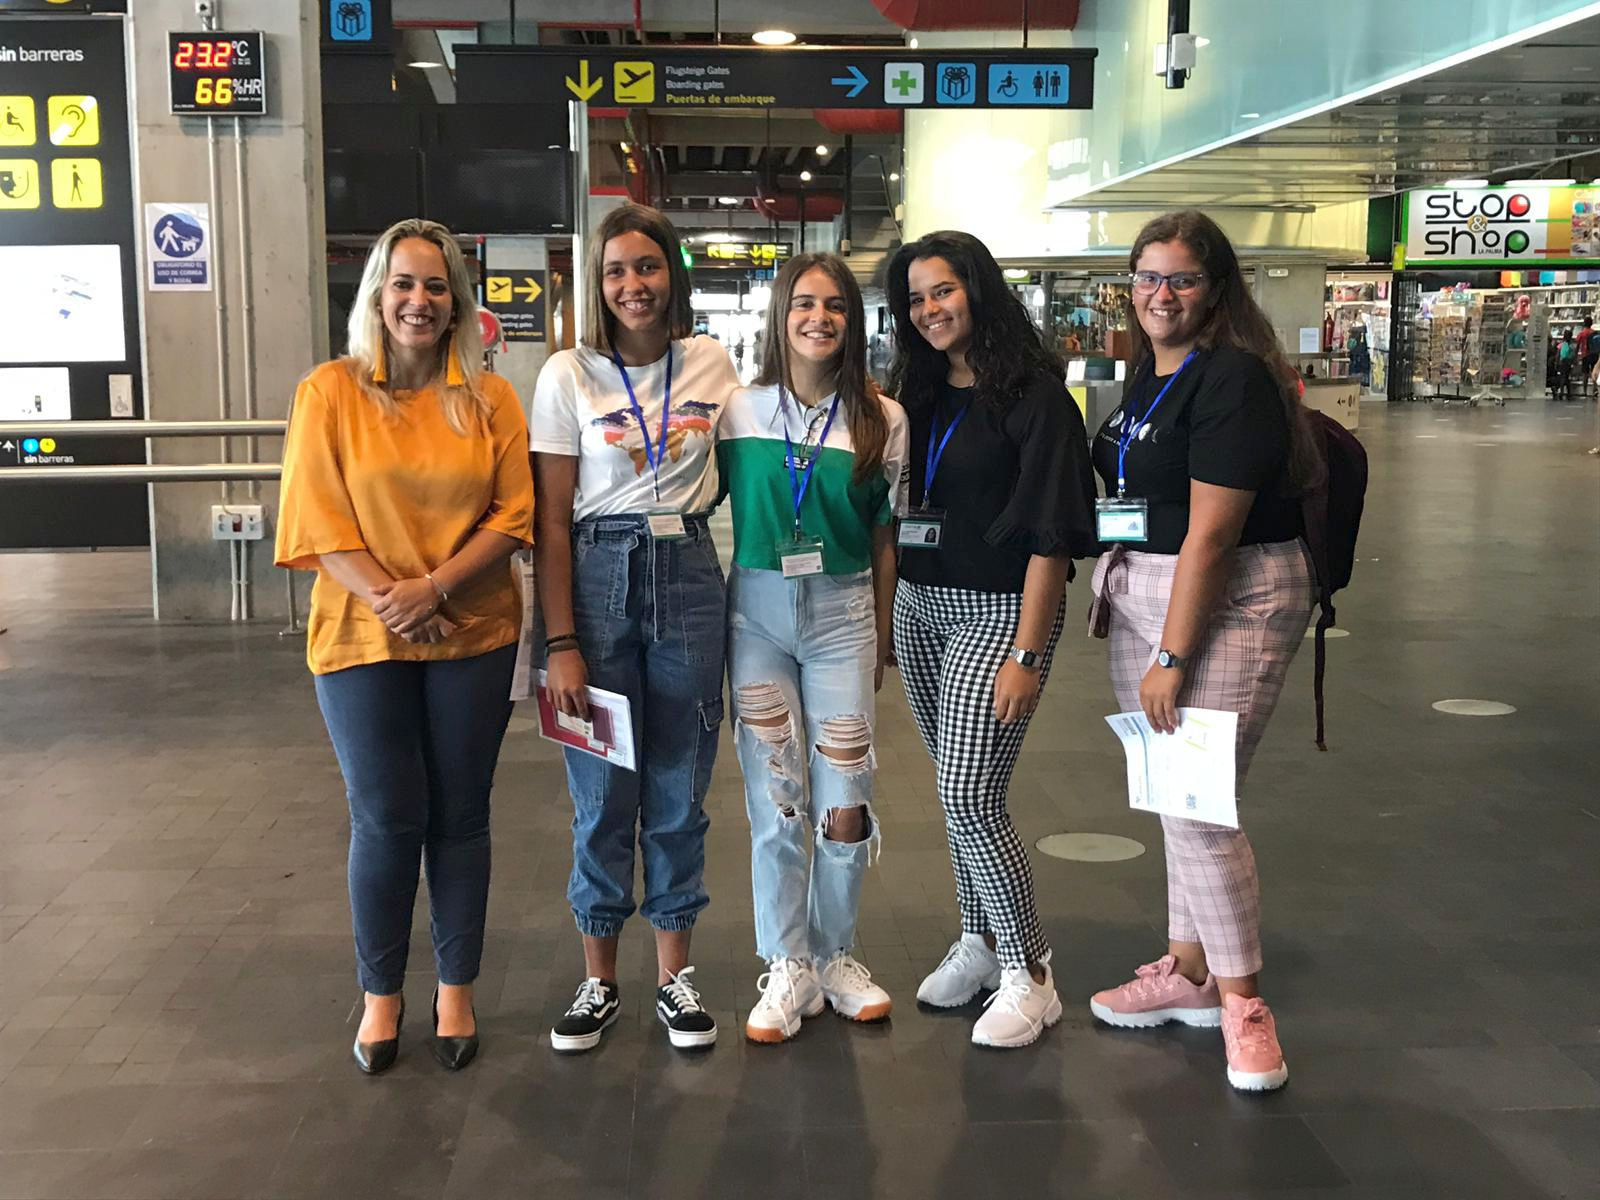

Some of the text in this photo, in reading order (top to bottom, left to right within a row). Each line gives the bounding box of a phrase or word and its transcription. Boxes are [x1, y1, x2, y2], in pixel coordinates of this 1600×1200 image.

[19, 46, 84, 62] barreras
[665, 80, 724, 90] Boarding gates
[195, 78, 232, 104] 66
[666, 94, 776, 105] Puertas de embarque
[23, 454, 75, 463] sin barreras
